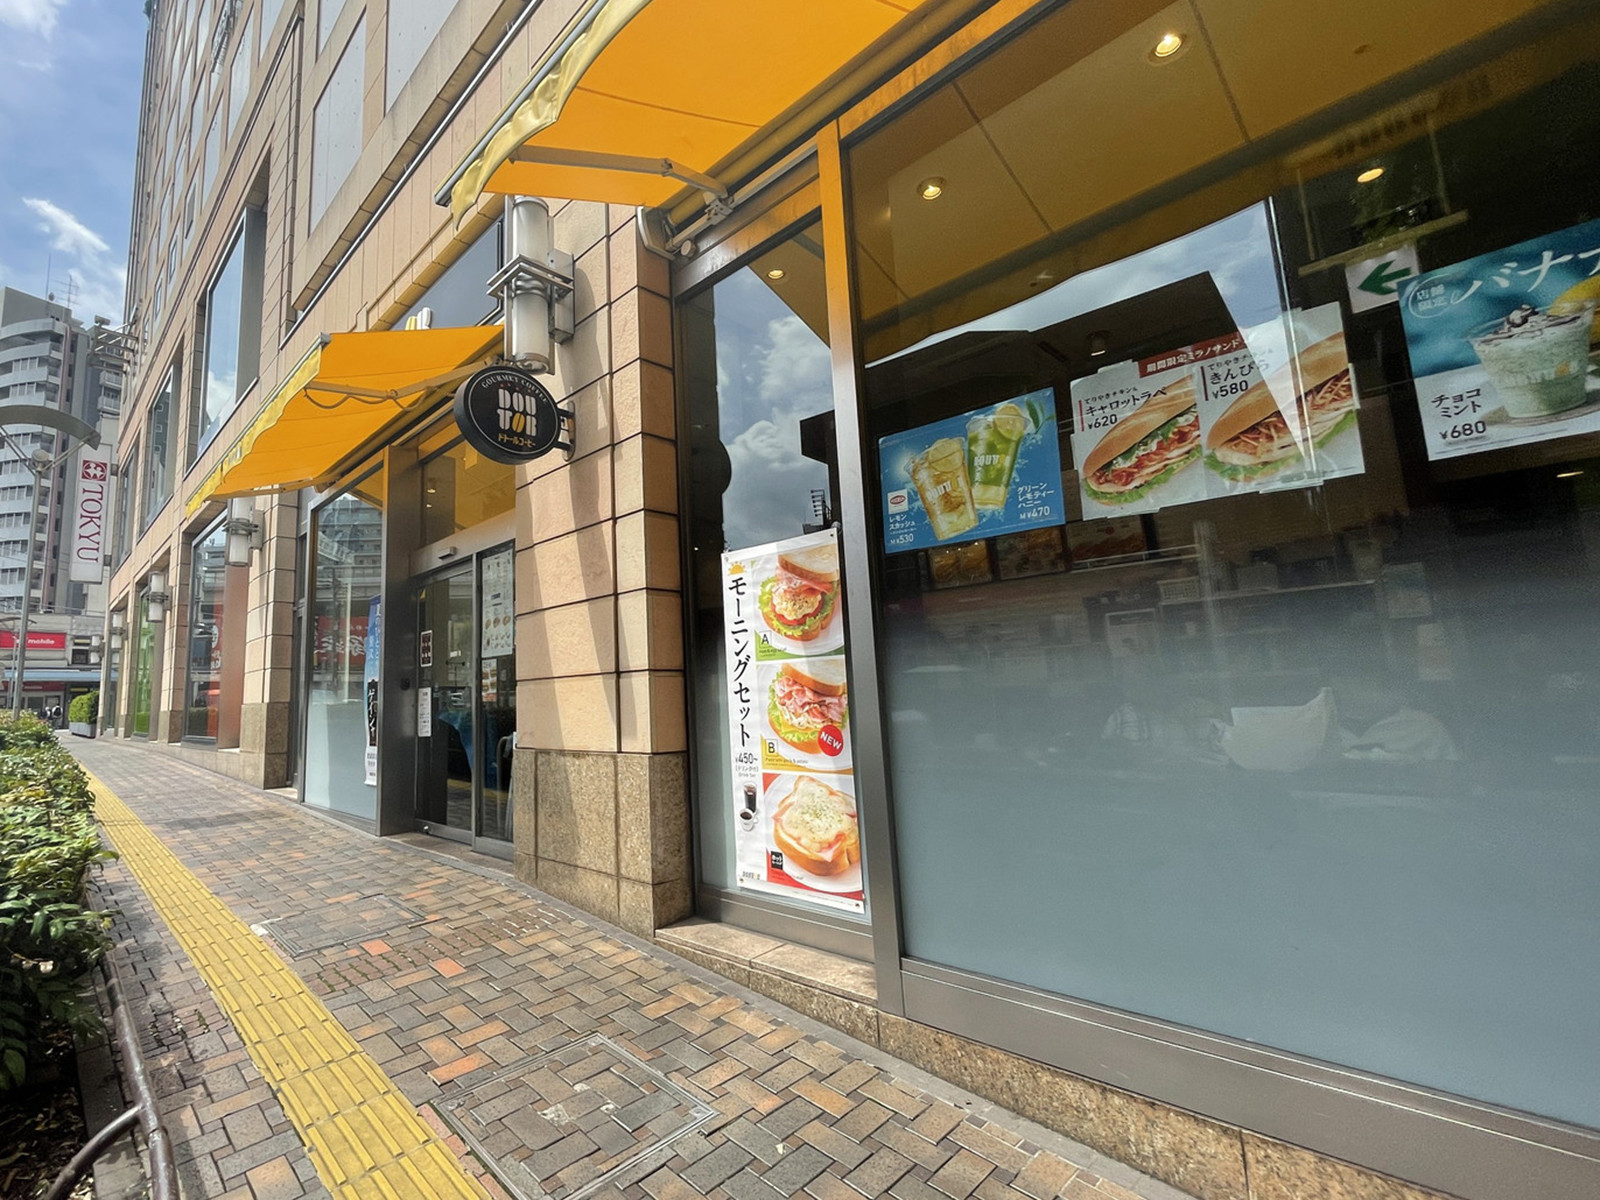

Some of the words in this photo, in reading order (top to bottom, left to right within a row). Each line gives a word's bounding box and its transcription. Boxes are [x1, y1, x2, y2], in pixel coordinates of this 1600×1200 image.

[1146, 338, 1240, 373] 期間限定ミラノサンド
[481, 374, 520, 389] GOURMET
[520, 380, 548, 405] COFFEE
[1212, 379, 1249, 399] ¥580
[1431, 388, 1481, 408] チョコ
[1085, 386, 1168, 417] キャロットラペ
[1440, 400, 1482, 418] ミント
[1087, 413, 1119, 430] ¥620
[1439, 420, 1487, 440] ¥680
[498, 433, 537, 448] ドトールコーヒー
[1017, 482, 1048, 495] グリーン
[1017, 500, 1042, 509] ハニー
[77, 484, 104, 563] TOKYU
[889, 514, 907, 523] レモン
[889, 521, 916, 531] スカッシュ
[760, 633, 769, 646] A
[728, 577, 751, 748] モーニングセット
[768, 742, 776, 754] B
[819, 730, 842, 750] NEW
